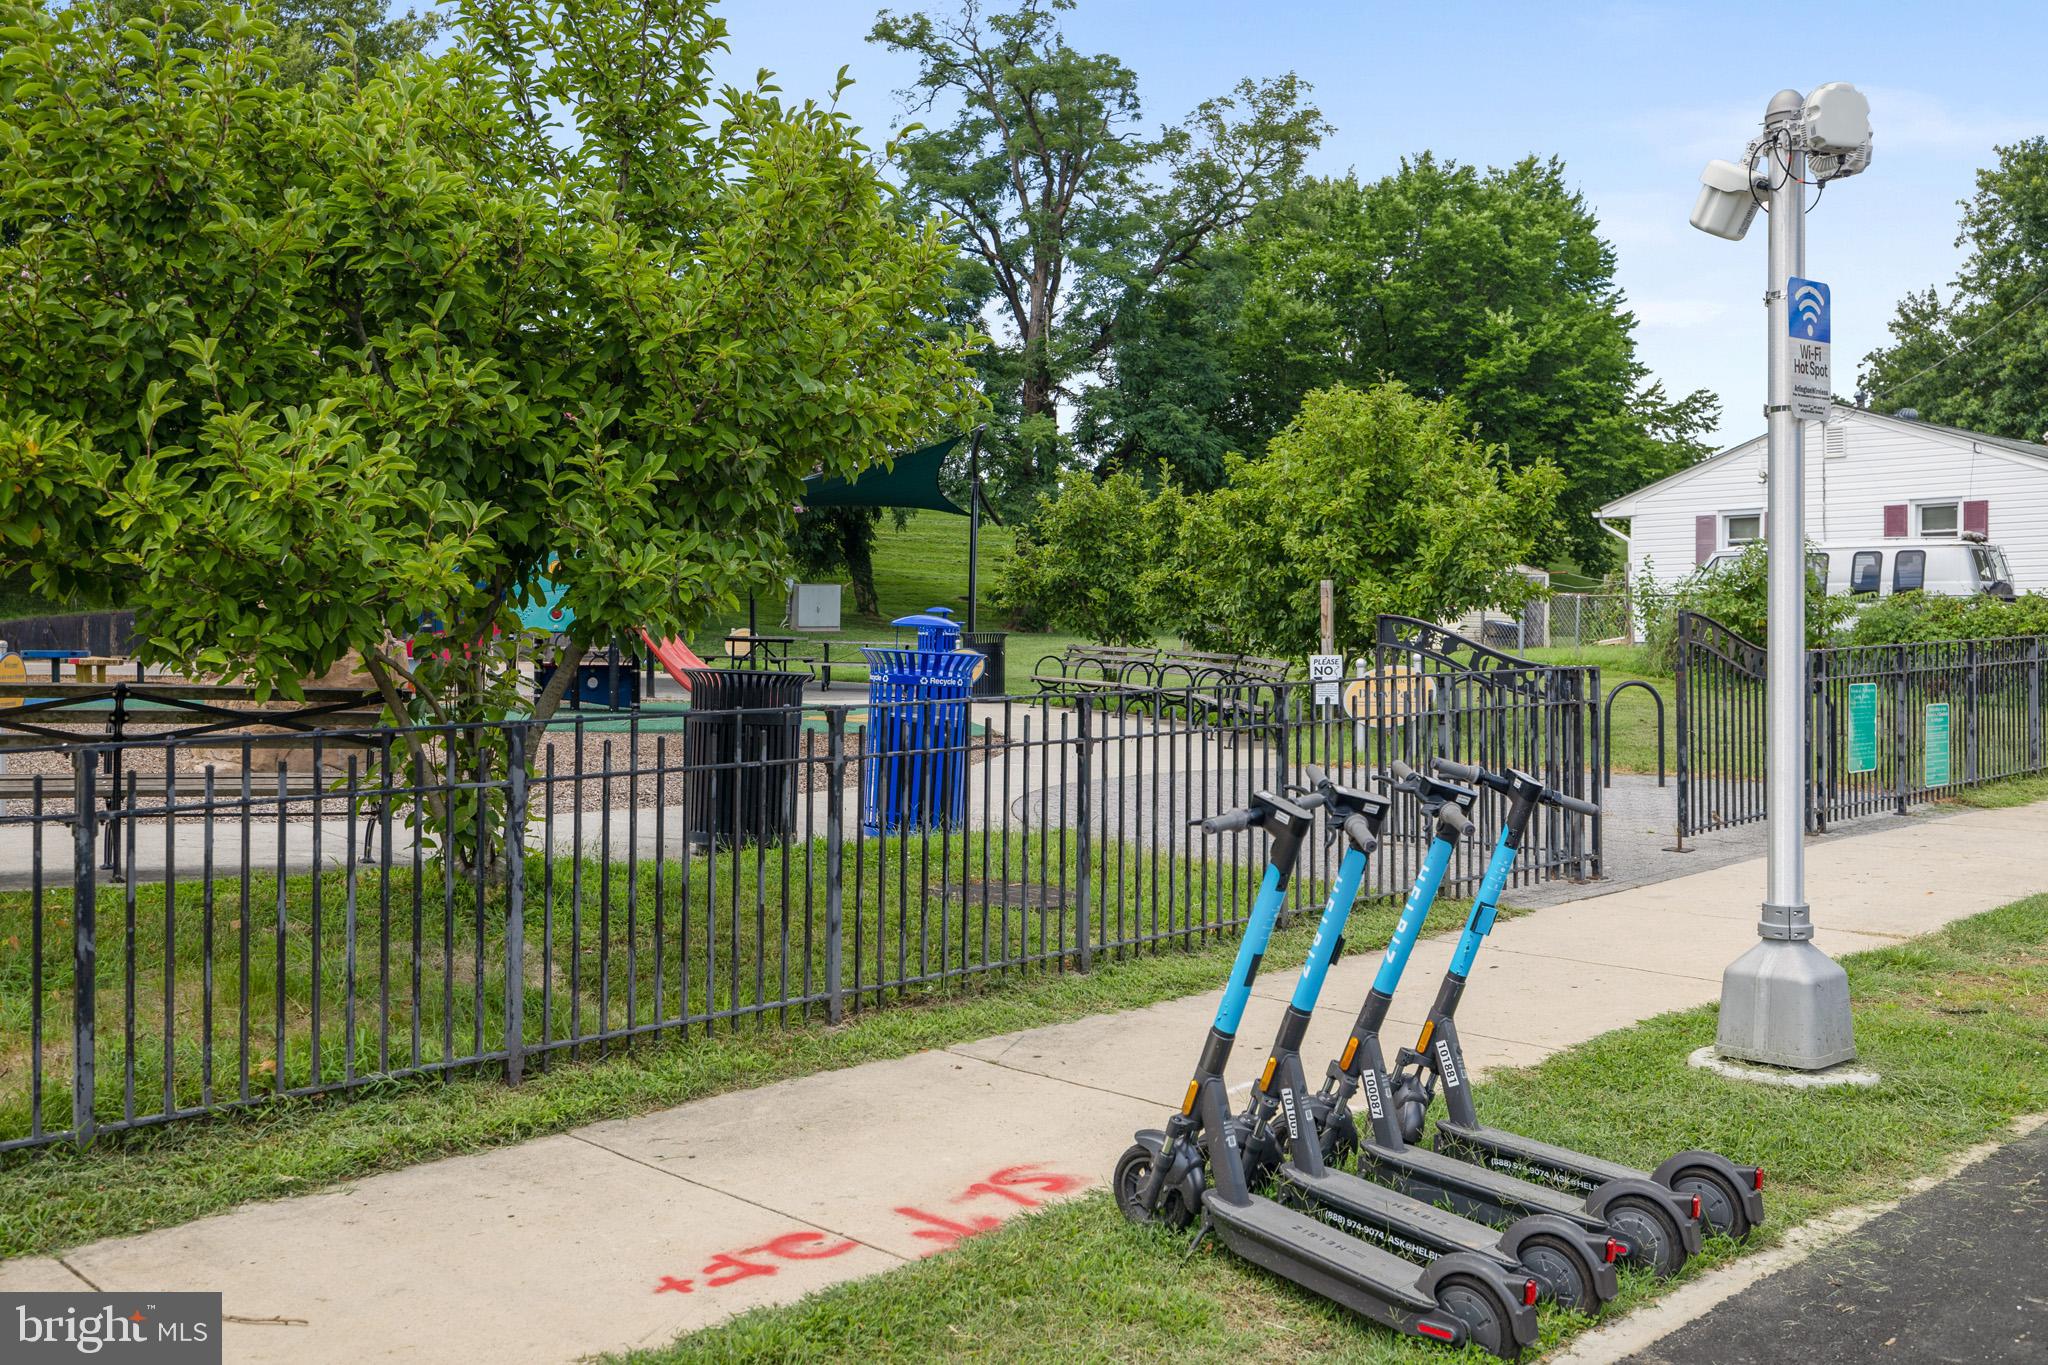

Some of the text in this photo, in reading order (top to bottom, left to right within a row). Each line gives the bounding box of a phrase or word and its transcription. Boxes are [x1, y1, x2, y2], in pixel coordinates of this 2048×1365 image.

[1800, 344, 1821, 361] Wi-Fi
[1794, 359, 1828, 380] Hot Spot
[1313, 658, 1340, 666] PLEASE
[1314, 666, 1334, 676] NO
[930, 677, 957, 687] Recycle
[1438, 1042, 1458, 1084] 101881
[1365, 1071, 1383, 1116] 100087
[1325, 1210, 1346, 1225] (888)
[1346, 1219, 1385, 1240] 974-9074
